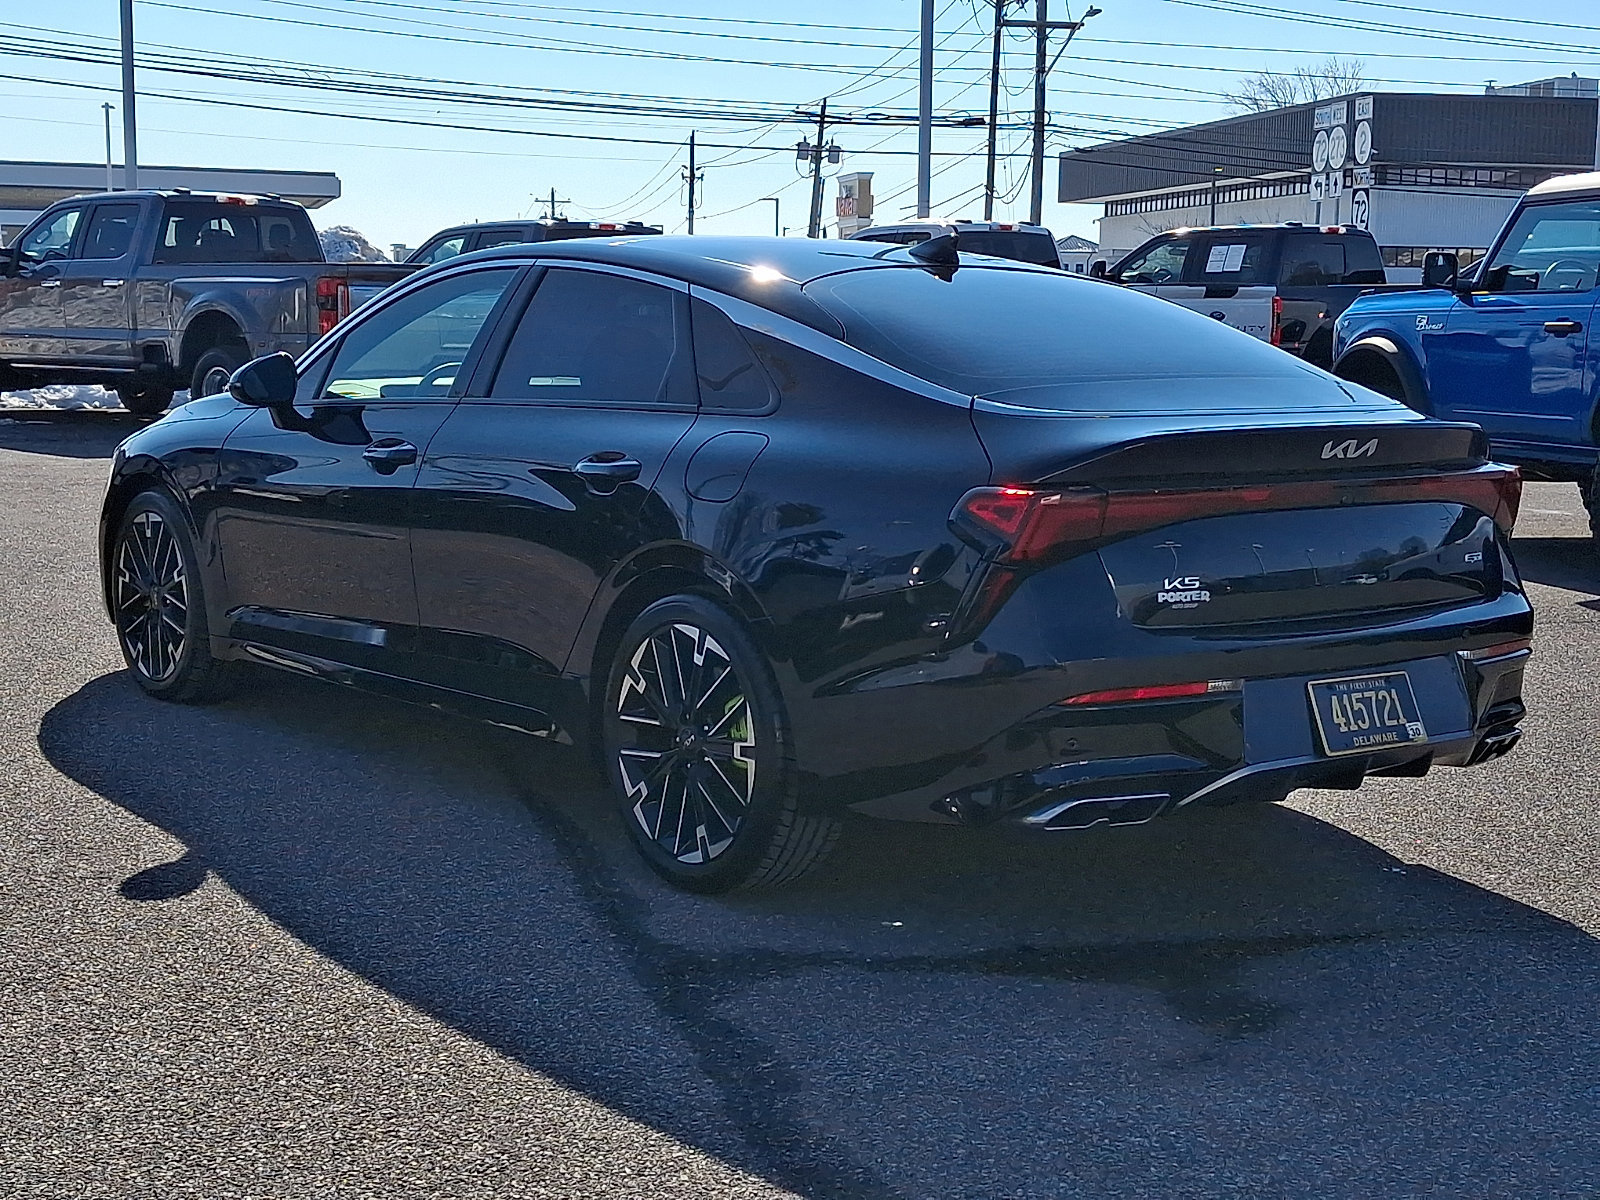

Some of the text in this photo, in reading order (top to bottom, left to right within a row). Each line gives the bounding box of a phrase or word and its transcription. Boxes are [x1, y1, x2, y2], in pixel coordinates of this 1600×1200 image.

[1358, 102, 1370, 116] EAST
[1315, 139, 1327, 163] 72
[1330, 135, 1345, 160] 273
[1360, 131, 1367, 155] 2
[1354, 200, 1367, 224] 72
[1321, 438, 1379, 459] KIA
[1164, 576, 1200, 590] K5
[1157, 590, 1211, 603] PORTER
[1331, 688, 1407, 732] 415721
[1353, 731, 1399, 746] DELAWARE
[1409, 727, 1421, 737] 30
